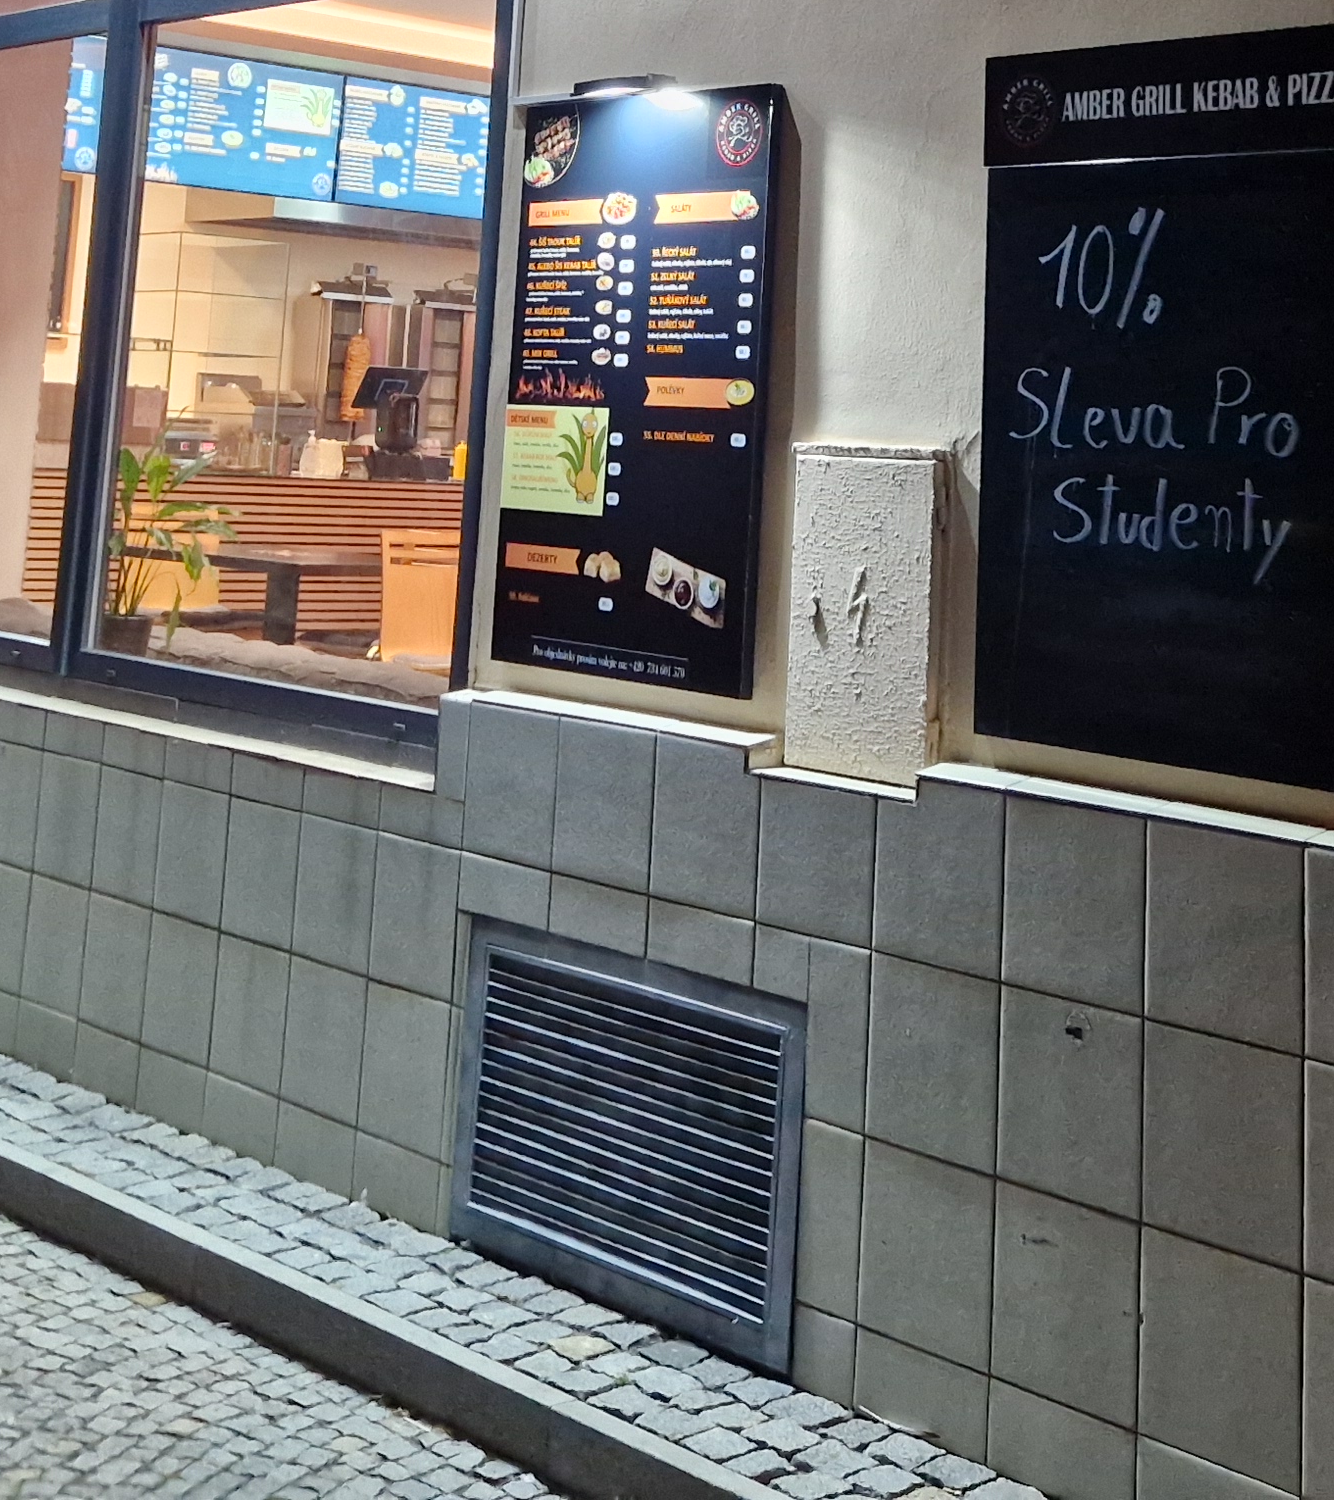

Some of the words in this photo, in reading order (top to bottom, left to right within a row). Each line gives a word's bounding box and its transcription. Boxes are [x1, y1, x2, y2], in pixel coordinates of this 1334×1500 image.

[1061, 88, 1125, 123] AMBER
[1131, 84, 1187, 118] GRILL
[1193, 76, 1259, 113] KEBAB
[1265, 75, 1280, 108] &
[1038, 207, 1165, 328] 10%
[656, 384, 685, 395] POLÉVKY
[1009, 366, 1185, 449] Sleva
[1208, 366, 1300, 458] Pro
[510, 413, 530, 424] DĚTSKÉ
[531, 416, 549, 425] MENU
[1052, 473, 1293, 585] Studenty
[527, 552, 558, 565] DEZERTY
